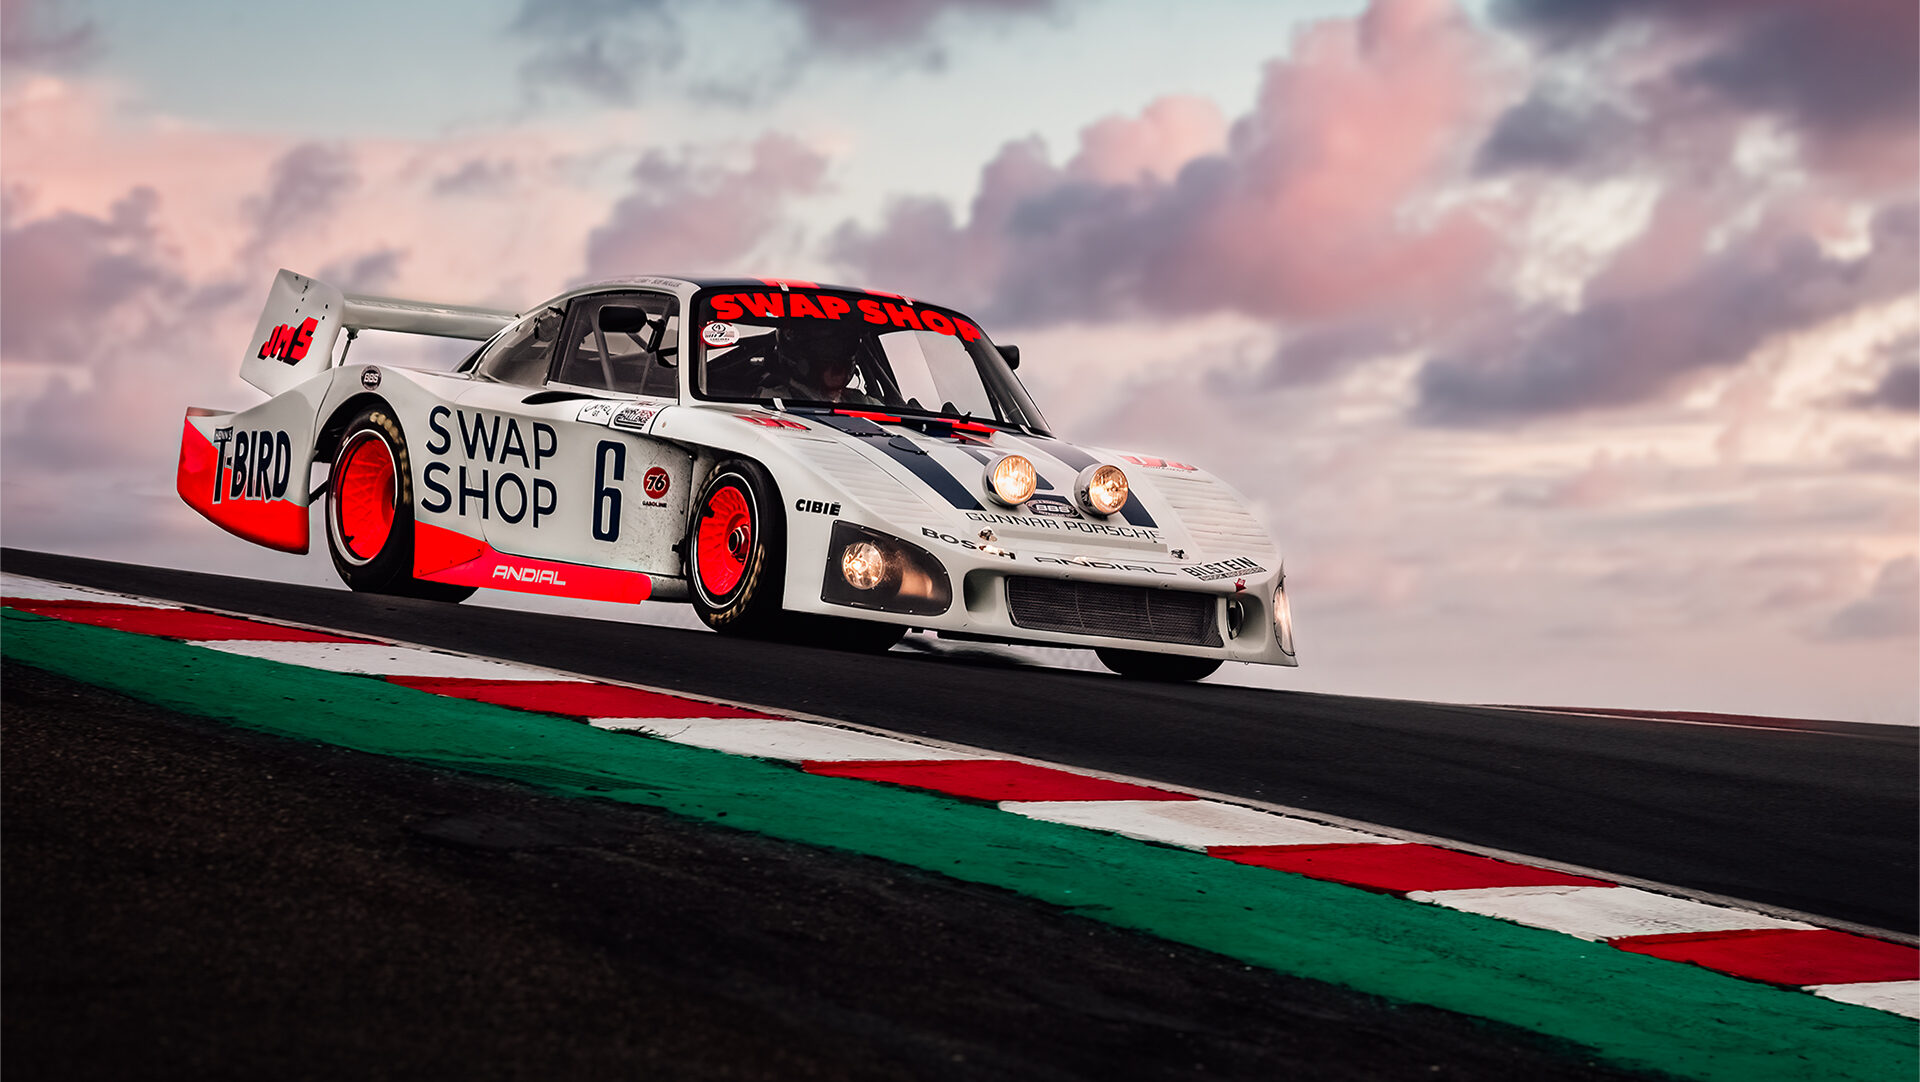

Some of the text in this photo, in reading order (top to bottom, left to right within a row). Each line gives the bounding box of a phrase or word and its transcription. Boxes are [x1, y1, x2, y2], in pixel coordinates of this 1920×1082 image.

[710, 293, 981, 343] SWAP SHOP
[257, 316, 319, 366] JMS
[584, 404, 612, 416] CAMEL
[426, 405, 557, 470] SWAP
[213, 427, 291, 503] T-BIRD
[421, 461, 557, 529] SHOP
[592, 439, 626, 542] 6
[645, 474, 667, 491] 76
[642, 499, 668, 508] GASOLINE
[965, 512, 1166, 540] GUNNAR PORSCHE
[921, 527, 1017, 560] BOSH
[492, 565, 567, 586] ANDIAL
[1034, 556, 1178, 576] ANDIAL
[1181, 557, 1260, 577] BILSTEIN
